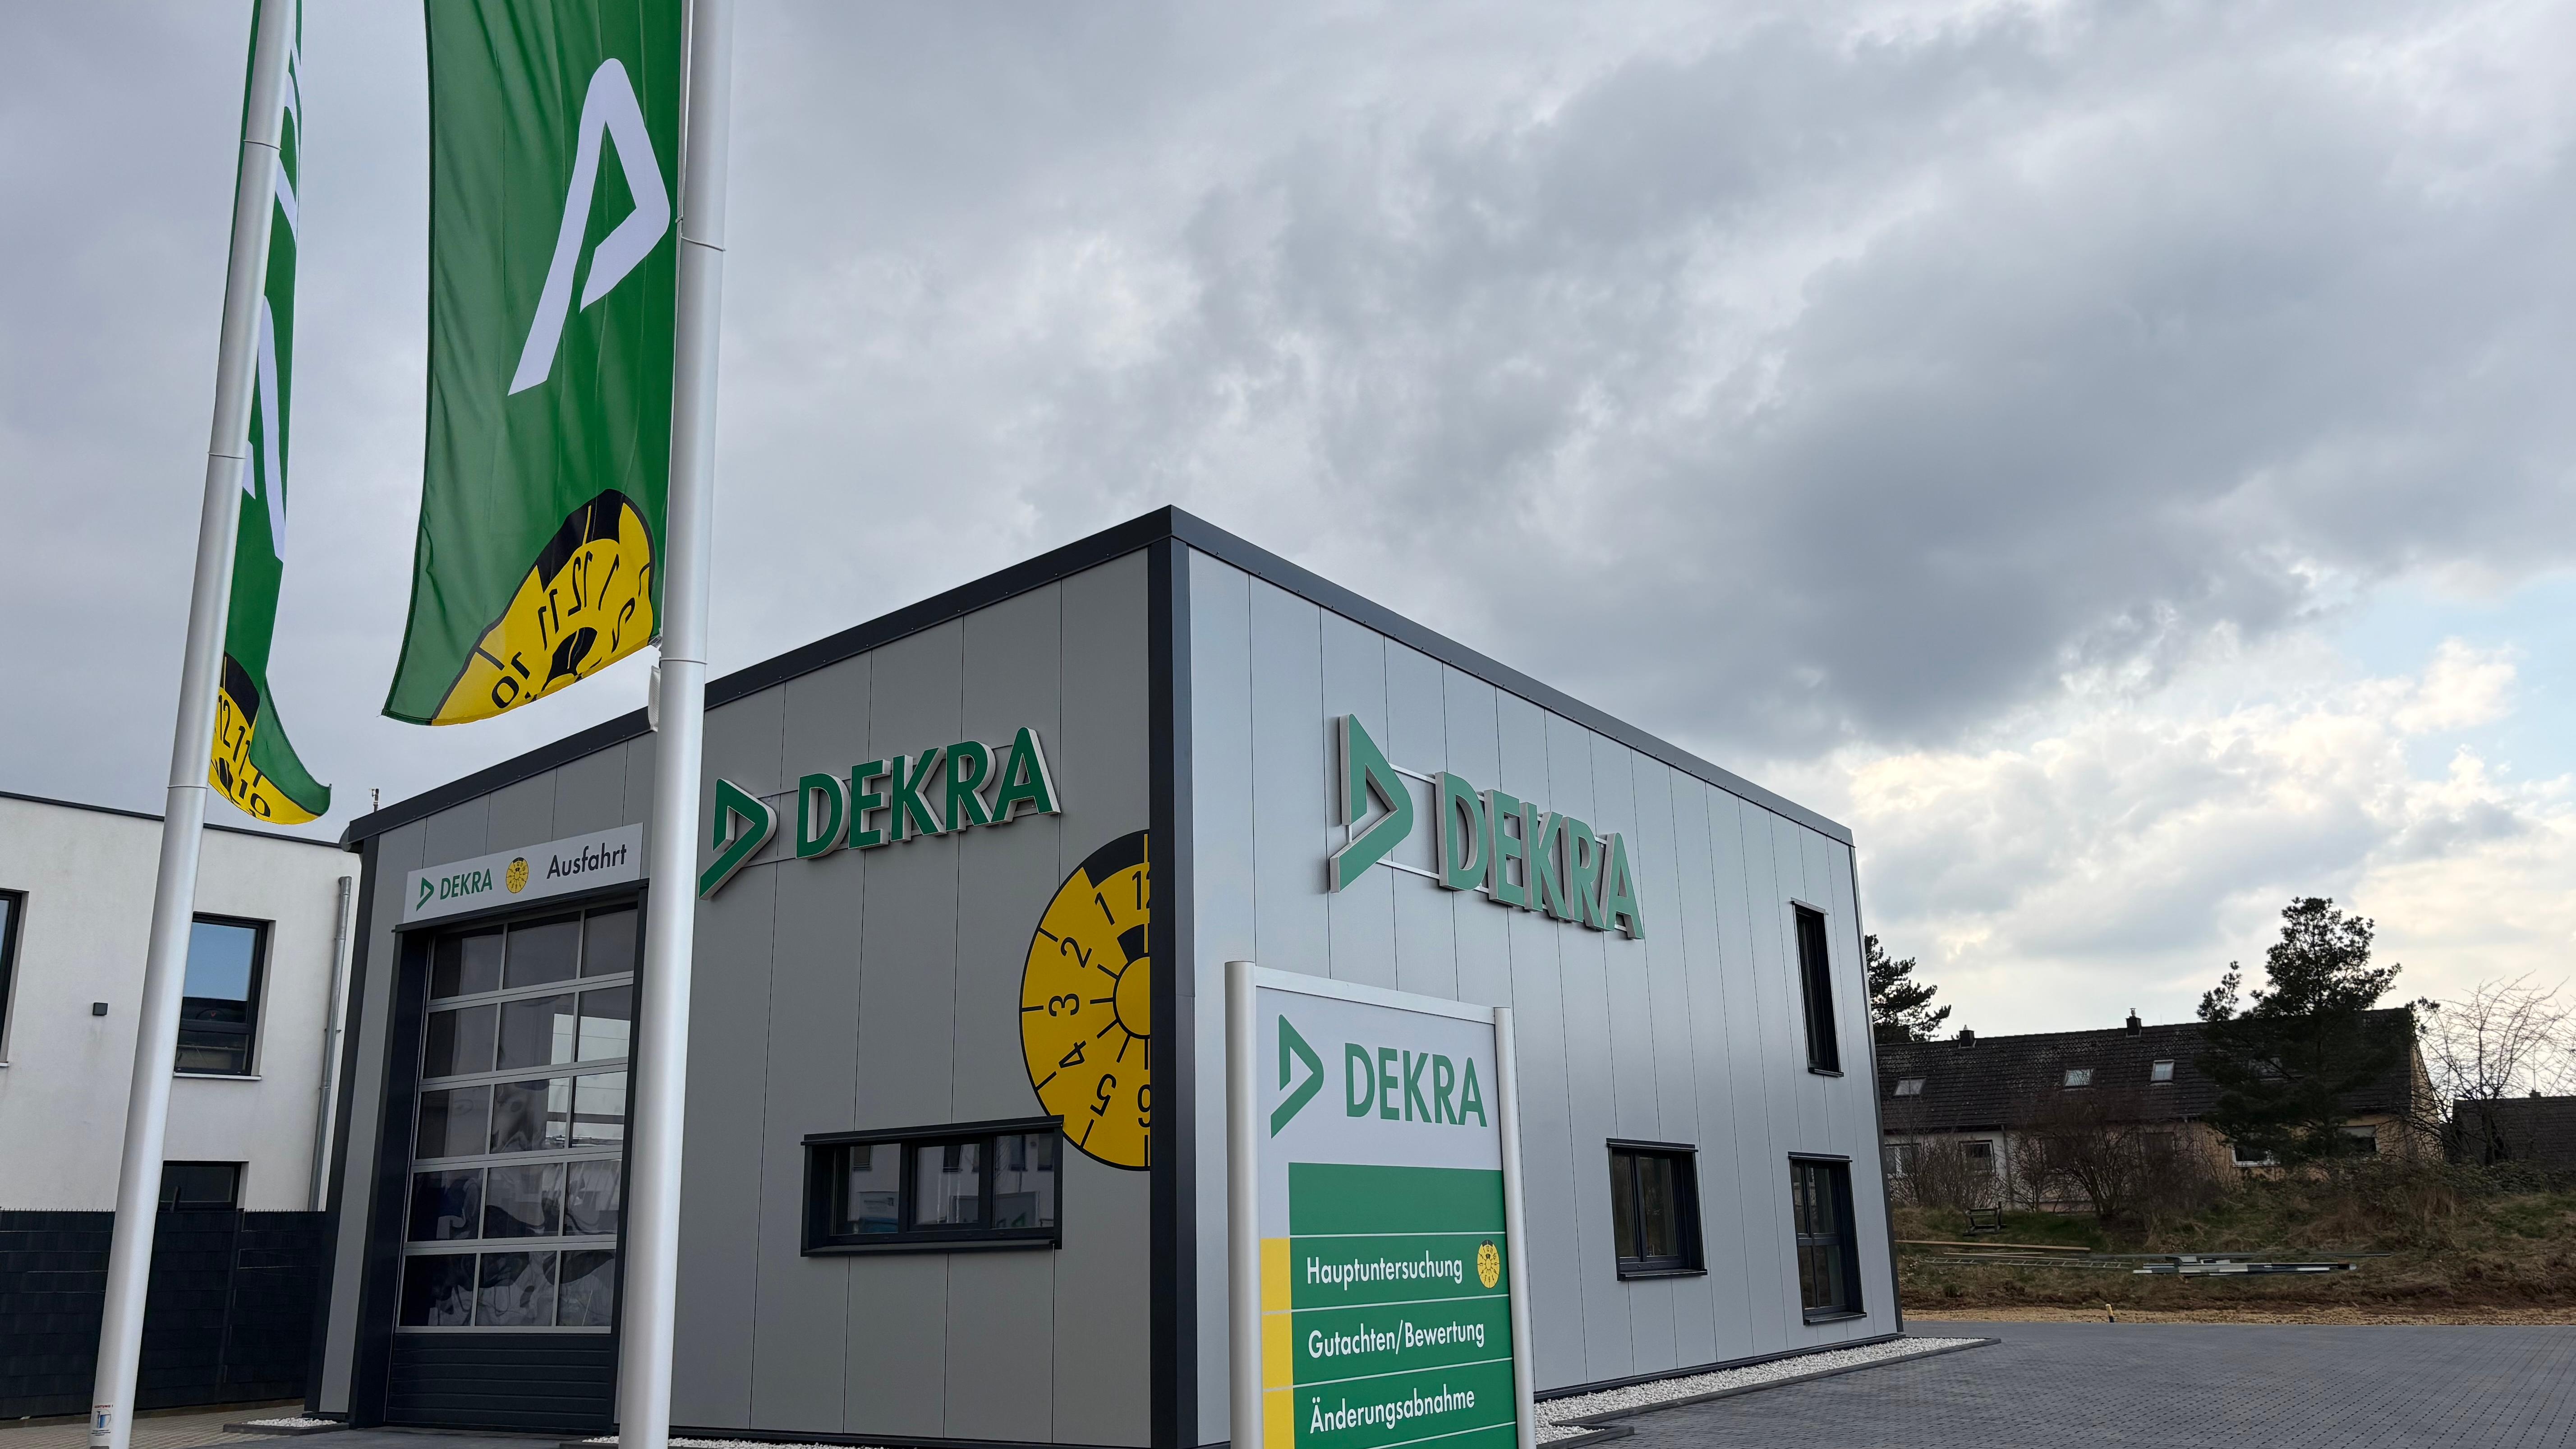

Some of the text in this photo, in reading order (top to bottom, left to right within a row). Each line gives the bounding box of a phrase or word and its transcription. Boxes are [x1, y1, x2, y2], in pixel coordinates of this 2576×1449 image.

[218, 695, 231, 749] 12
[239, 778, 271, 818] 10
[796, 727, 1060, 859] DEKRA
[440, 868, 492, 900] DEKRA
[546, 842, 627, 879] Ausfahrt
[1435, 771, 1644, 939] DEKRA
[1094, 892, 1115, 926] 1
[1132, 870, 1150, 910] 1
[1060, 936, 1092, 968] 2
[1048, 993, 1080, 1017] 3
[1058, 1040, 1087, 1068] 4
[1090, 1073, 1117, 1117] 5
[1344, 1042, 1488, 1127] DEKRA
[1307, 1250, 1463, 1291] Hauptuntersuchung
[1308, 1320, 1485, 1358] Gutachten/Bewertung
[1310, 1384, 1475, 1434] Änderungsabnahme
